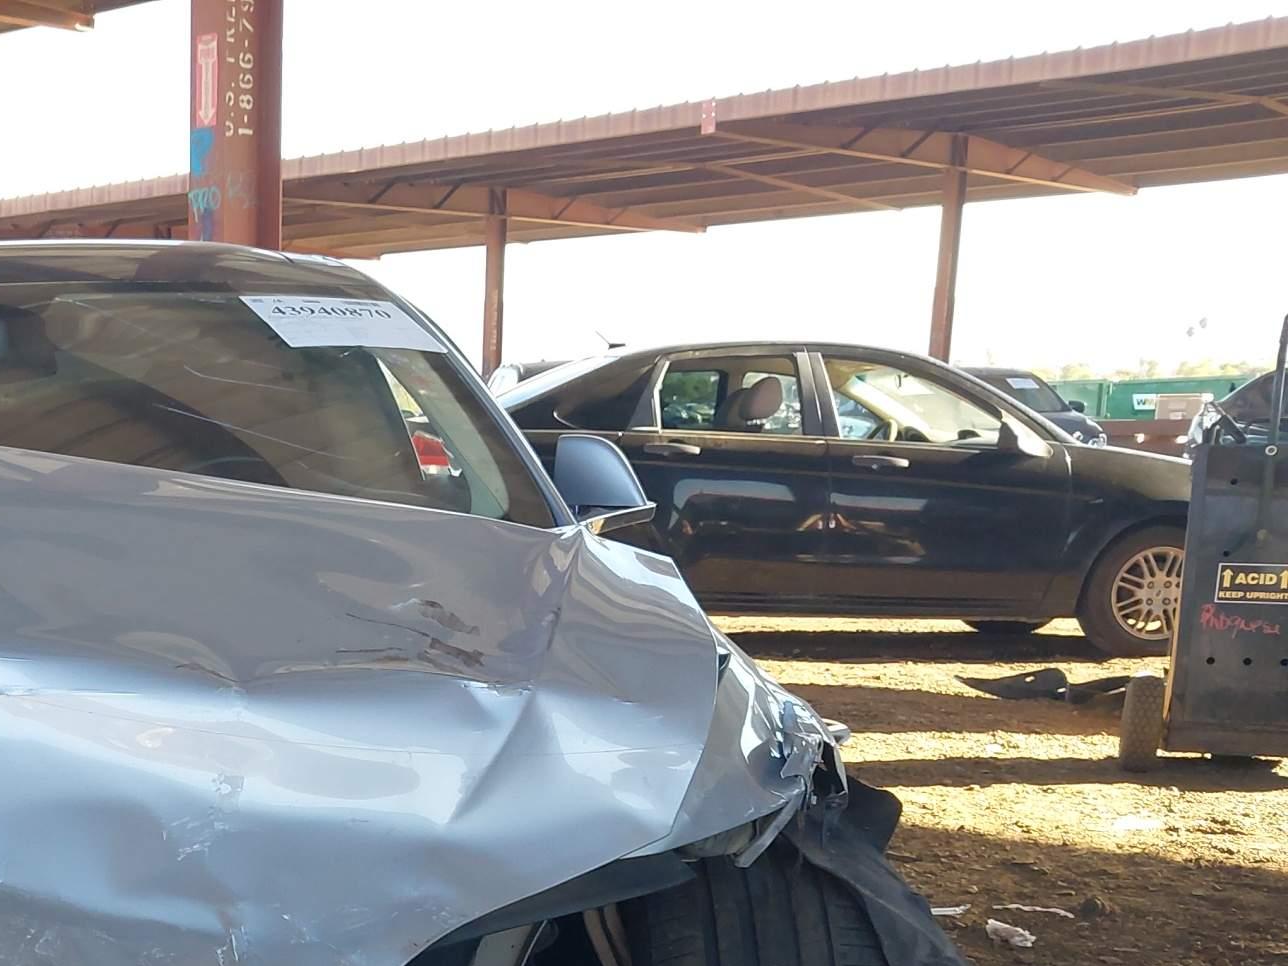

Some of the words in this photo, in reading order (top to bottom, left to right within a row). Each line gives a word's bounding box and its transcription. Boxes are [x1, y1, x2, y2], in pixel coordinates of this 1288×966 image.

[272, 305, 393, 320] 43940870
[1234, 572, 1278, 585] ACID
[1218, 590, 1245, 599] KEEP
[1246, 591, 1288, 600] UPRIGHT
